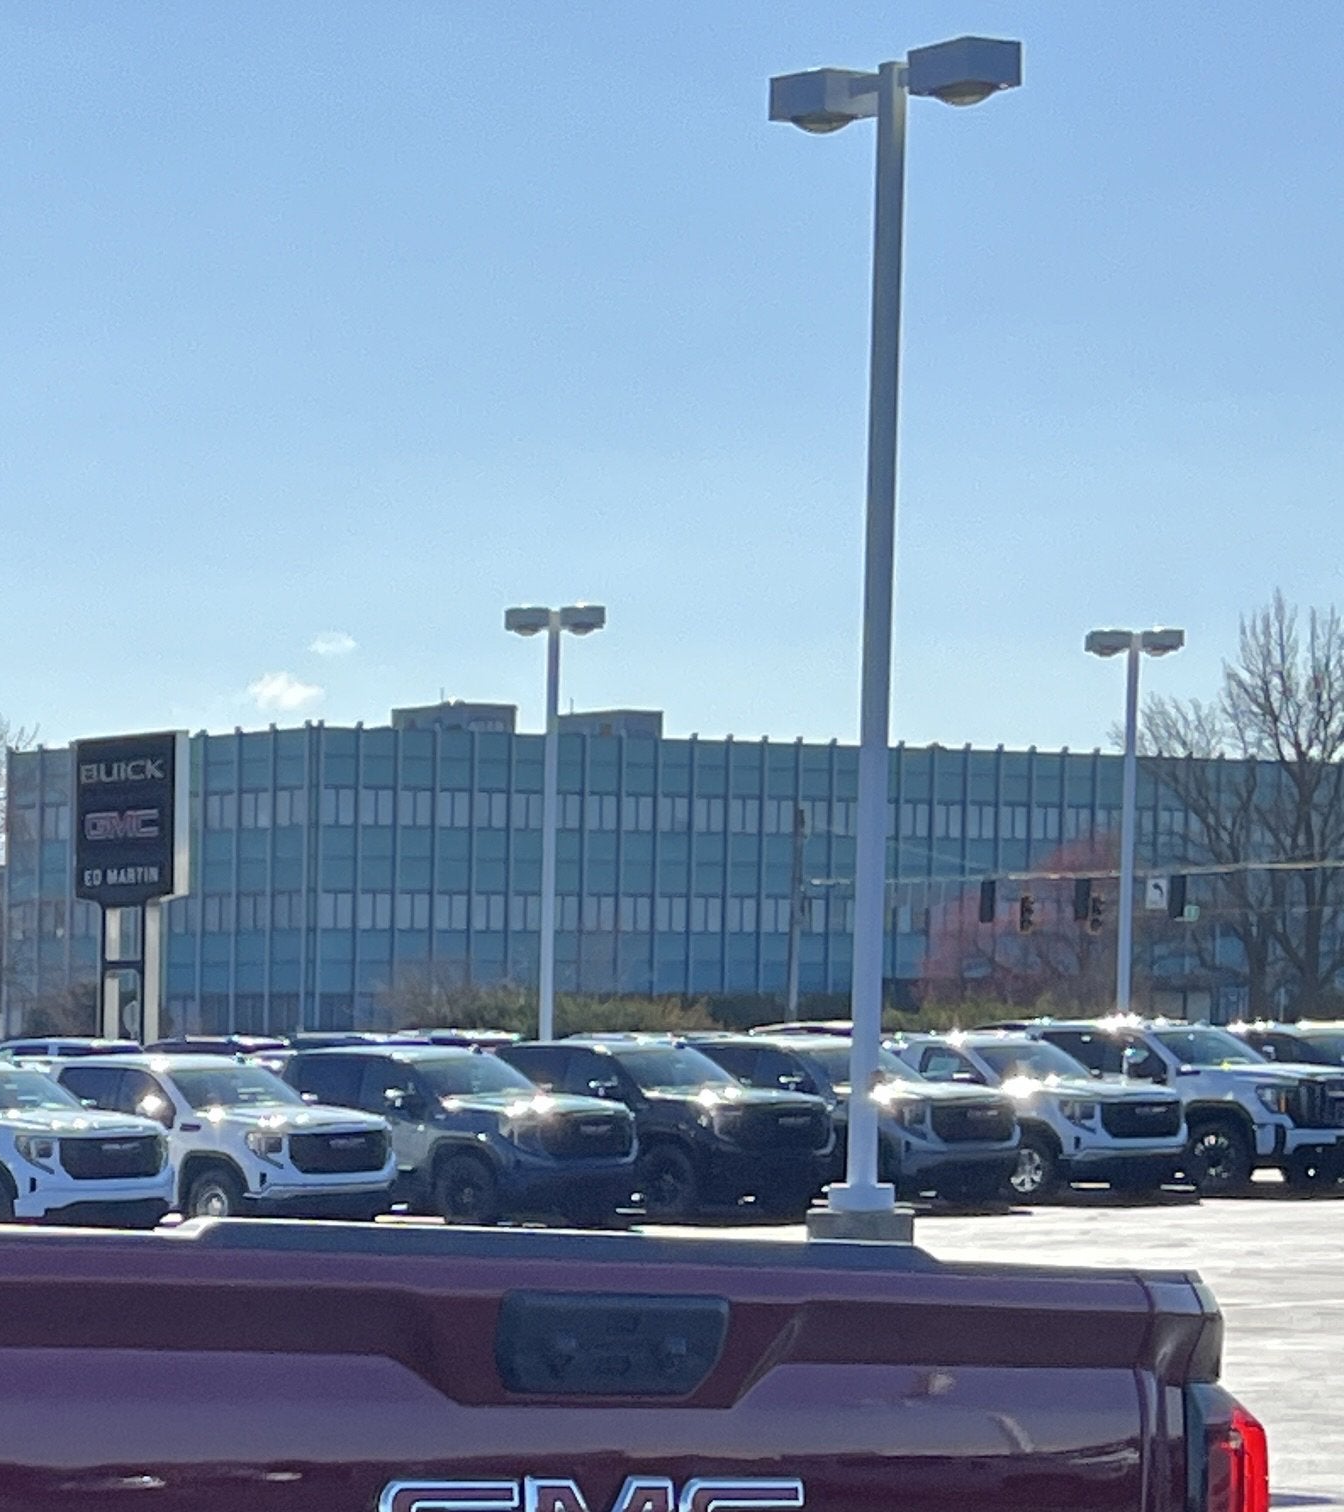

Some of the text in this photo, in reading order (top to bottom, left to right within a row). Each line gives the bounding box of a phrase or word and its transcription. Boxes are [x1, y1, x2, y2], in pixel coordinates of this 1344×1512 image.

[80, 759, 164, 784] BUICK
[85, 808, 159, 840] GMC
[84, 866, 159, 887] ED MARTIN
